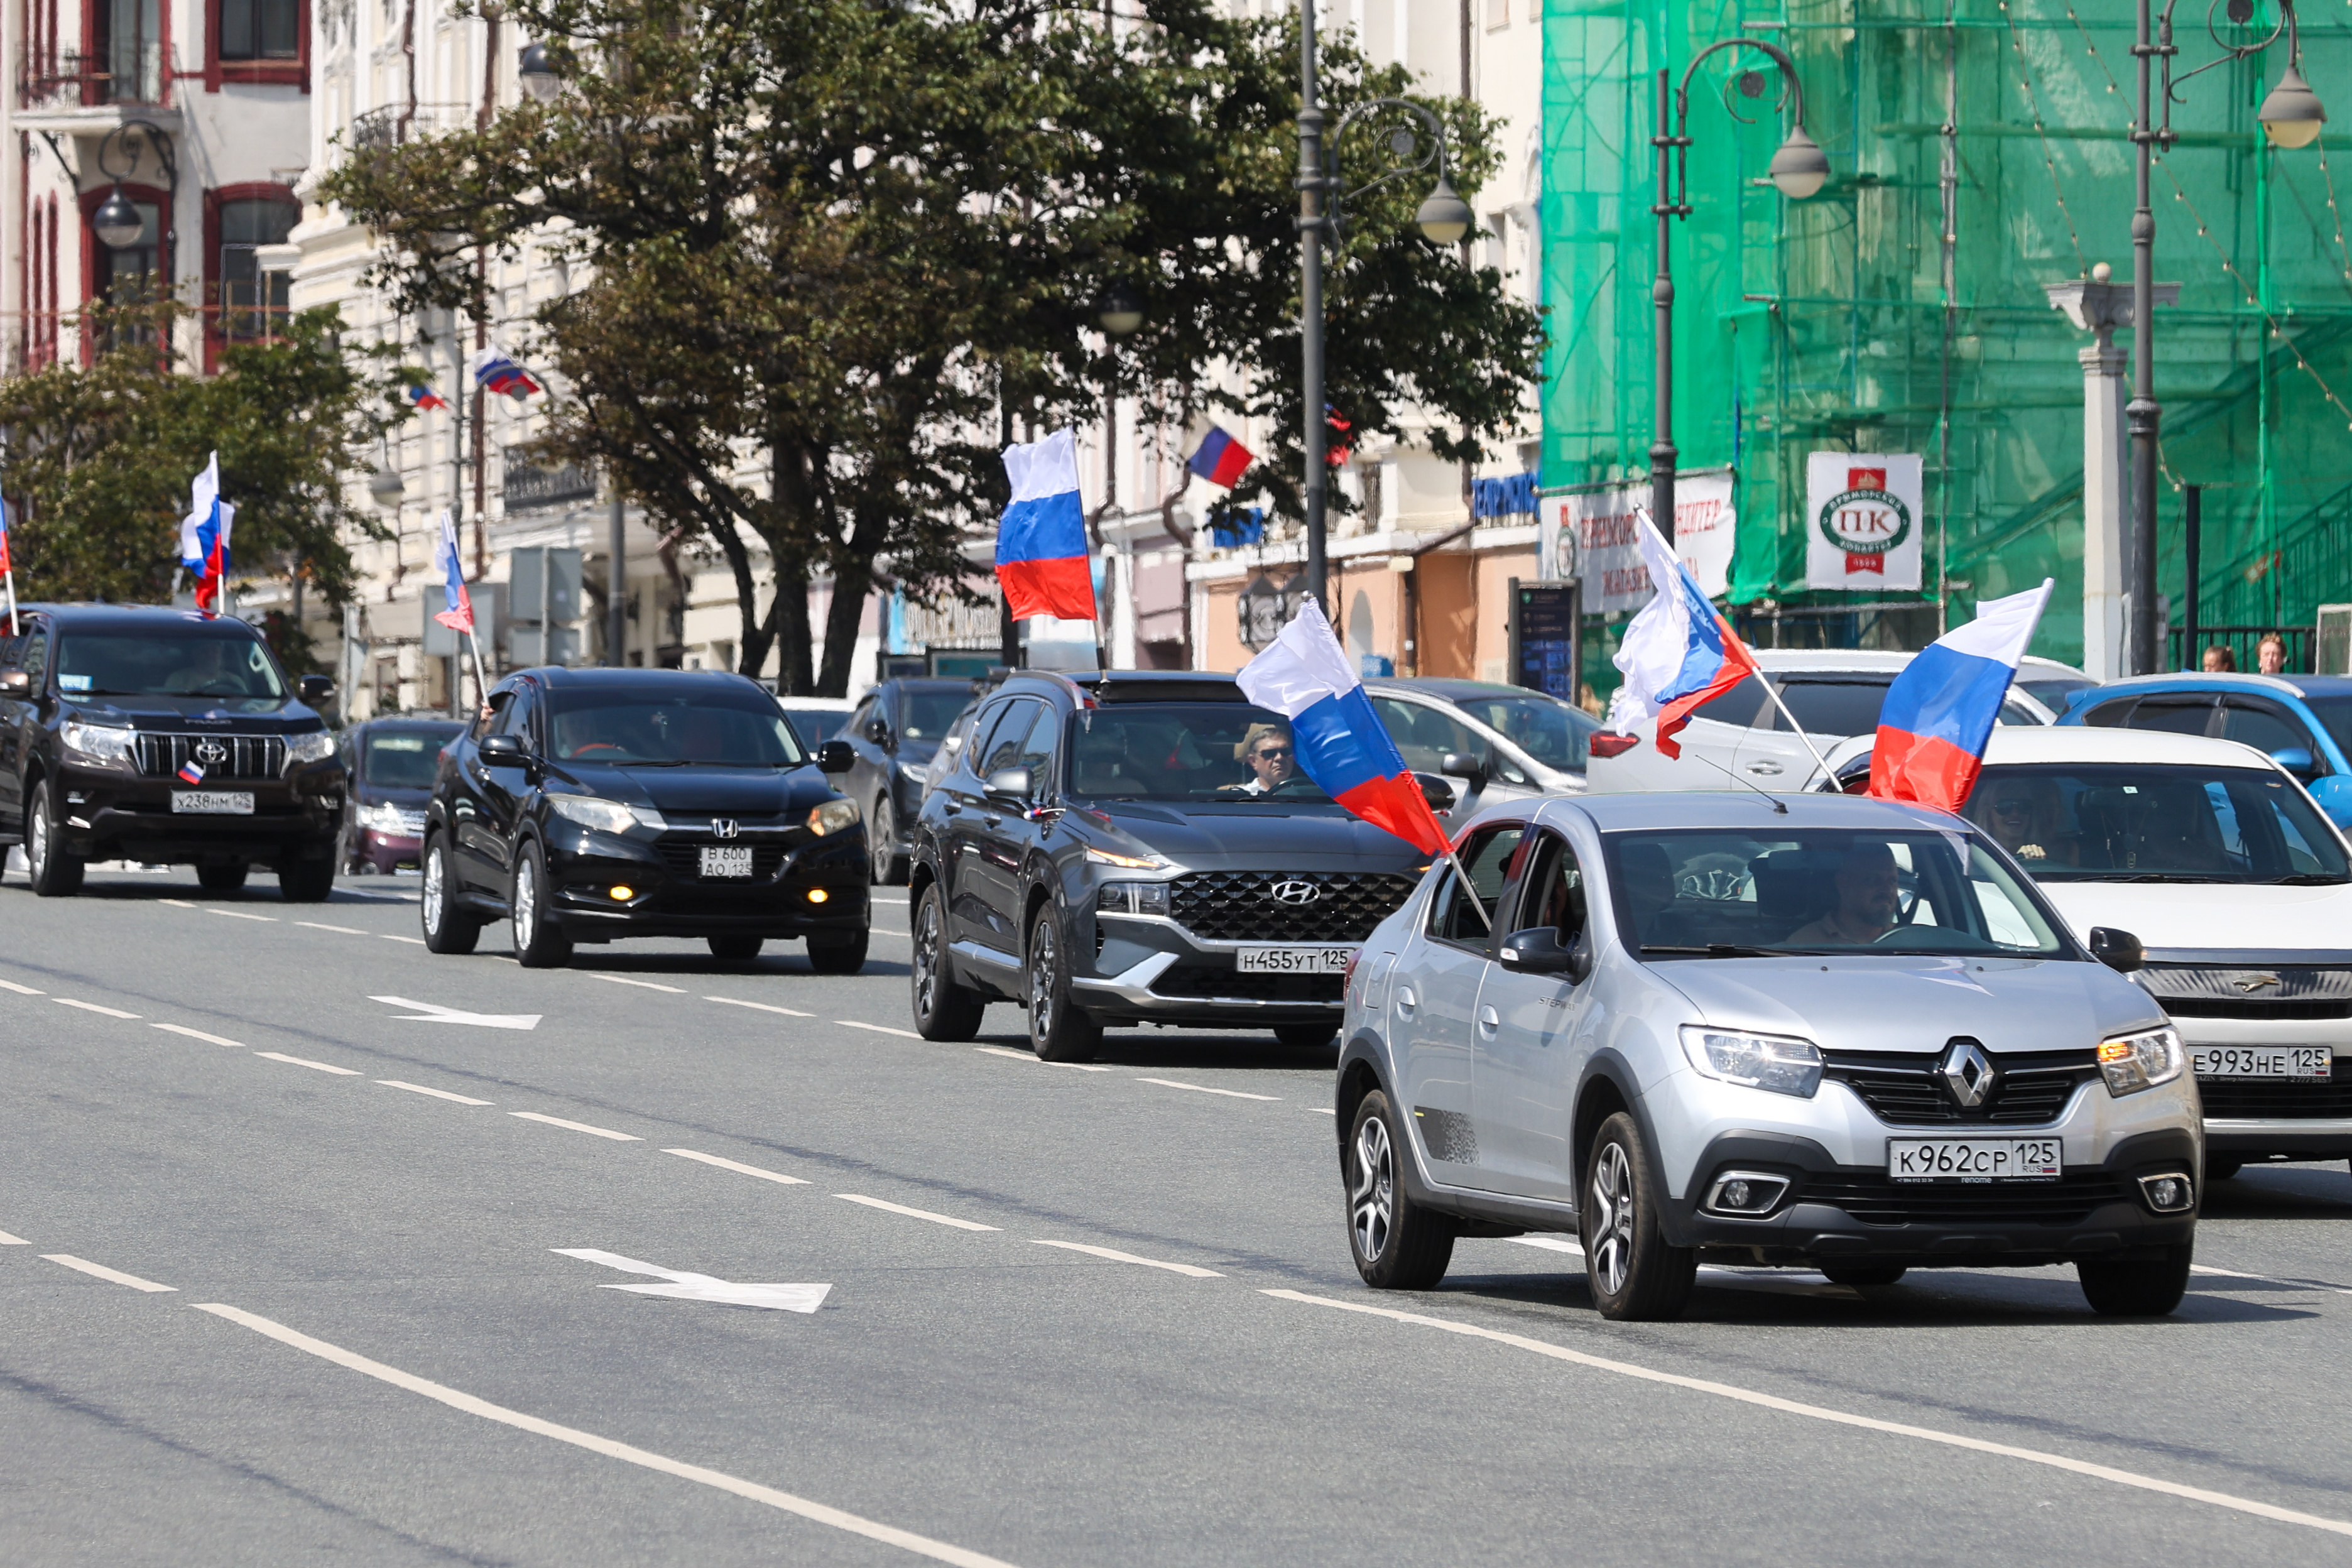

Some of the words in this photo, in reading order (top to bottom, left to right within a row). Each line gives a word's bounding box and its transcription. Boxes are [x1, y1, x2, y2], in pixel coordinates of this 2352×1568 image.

[1840, 509, 1892, 533] ПК
[722, 846, 746, 860] 600
[731, 864, 752, 874] 125
[1244, 950, 1317, 970] Н455УТ
[1321, 950, 1348, 966] 125
[1538, 996, 1575, 1011] STEPWAY
[2194, 1049, 2285, 1074] Е993НЕ
[2290, 1049, 2325, 1067] 125
[1900, 1145, 2008, 1173] К962СР
[2015, 1143, 2054, 1165] 125
